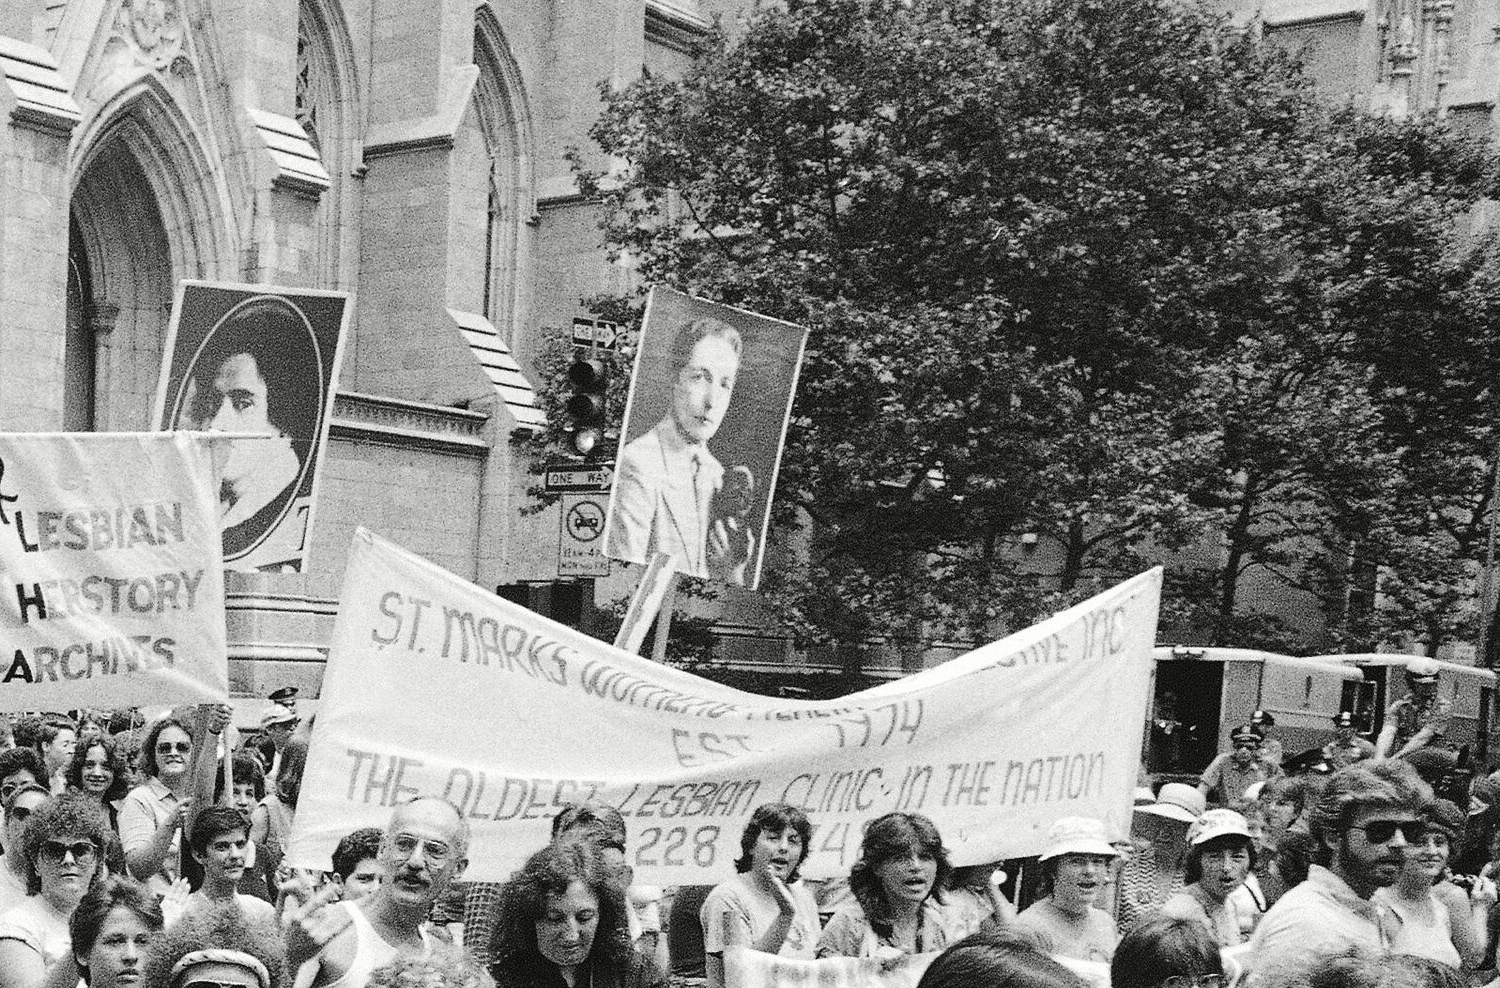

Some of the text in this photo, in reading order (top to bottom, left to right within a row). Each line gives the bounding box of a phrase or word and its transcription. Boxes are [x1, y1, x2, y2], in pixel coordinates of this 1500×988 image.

[552, 471, 611, 484] ONE WAY
[15, 502, 185, 552] LESBIAN
[15, 569, 205, 624] HERSTORY
[372, 591, 431, 653] ST.
[1081, 606, 1127, 660] INC
[346, 748, 424, 808] THE
[444, 767, 608, 822] OLDEST
[615, 778, 762, 819] LESBIAN
[894, 763, 934, 811] IN
[942, 760, 997, 808] THE
[1000, 751, 1106, 806] NATION
